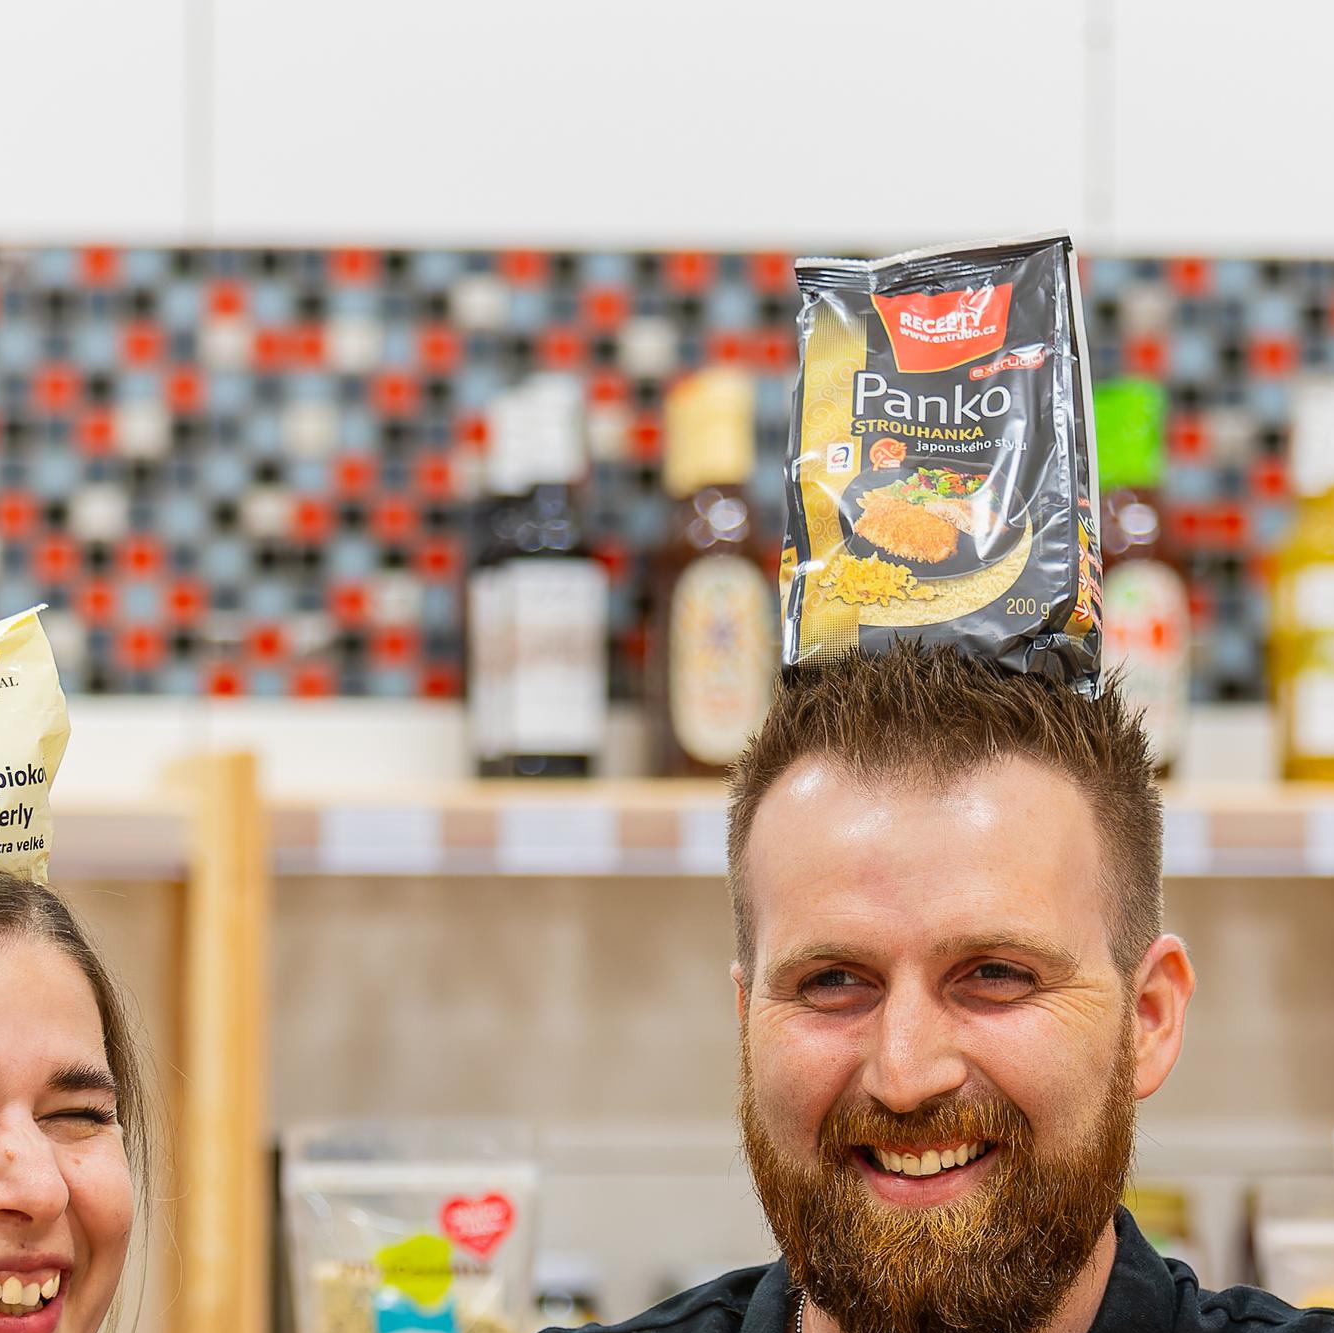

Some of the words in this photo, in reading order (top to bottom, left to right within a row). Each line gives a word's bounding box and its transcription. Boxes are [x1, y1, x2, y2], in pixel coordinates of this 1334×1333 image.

[900, 311, 983, 333] RECEPTY
[900, 324, 997, 345] www.extrudo.cz
[854, 372, 1011, 425] Panko
[854, 419, 985, 441] STROUHANKA
[915, 440, 991, 454] japonského
[1006, 597, 1036, 615] 200
[1040, 601, 1051, 620] g
[16, 834, 45, 852] velké
